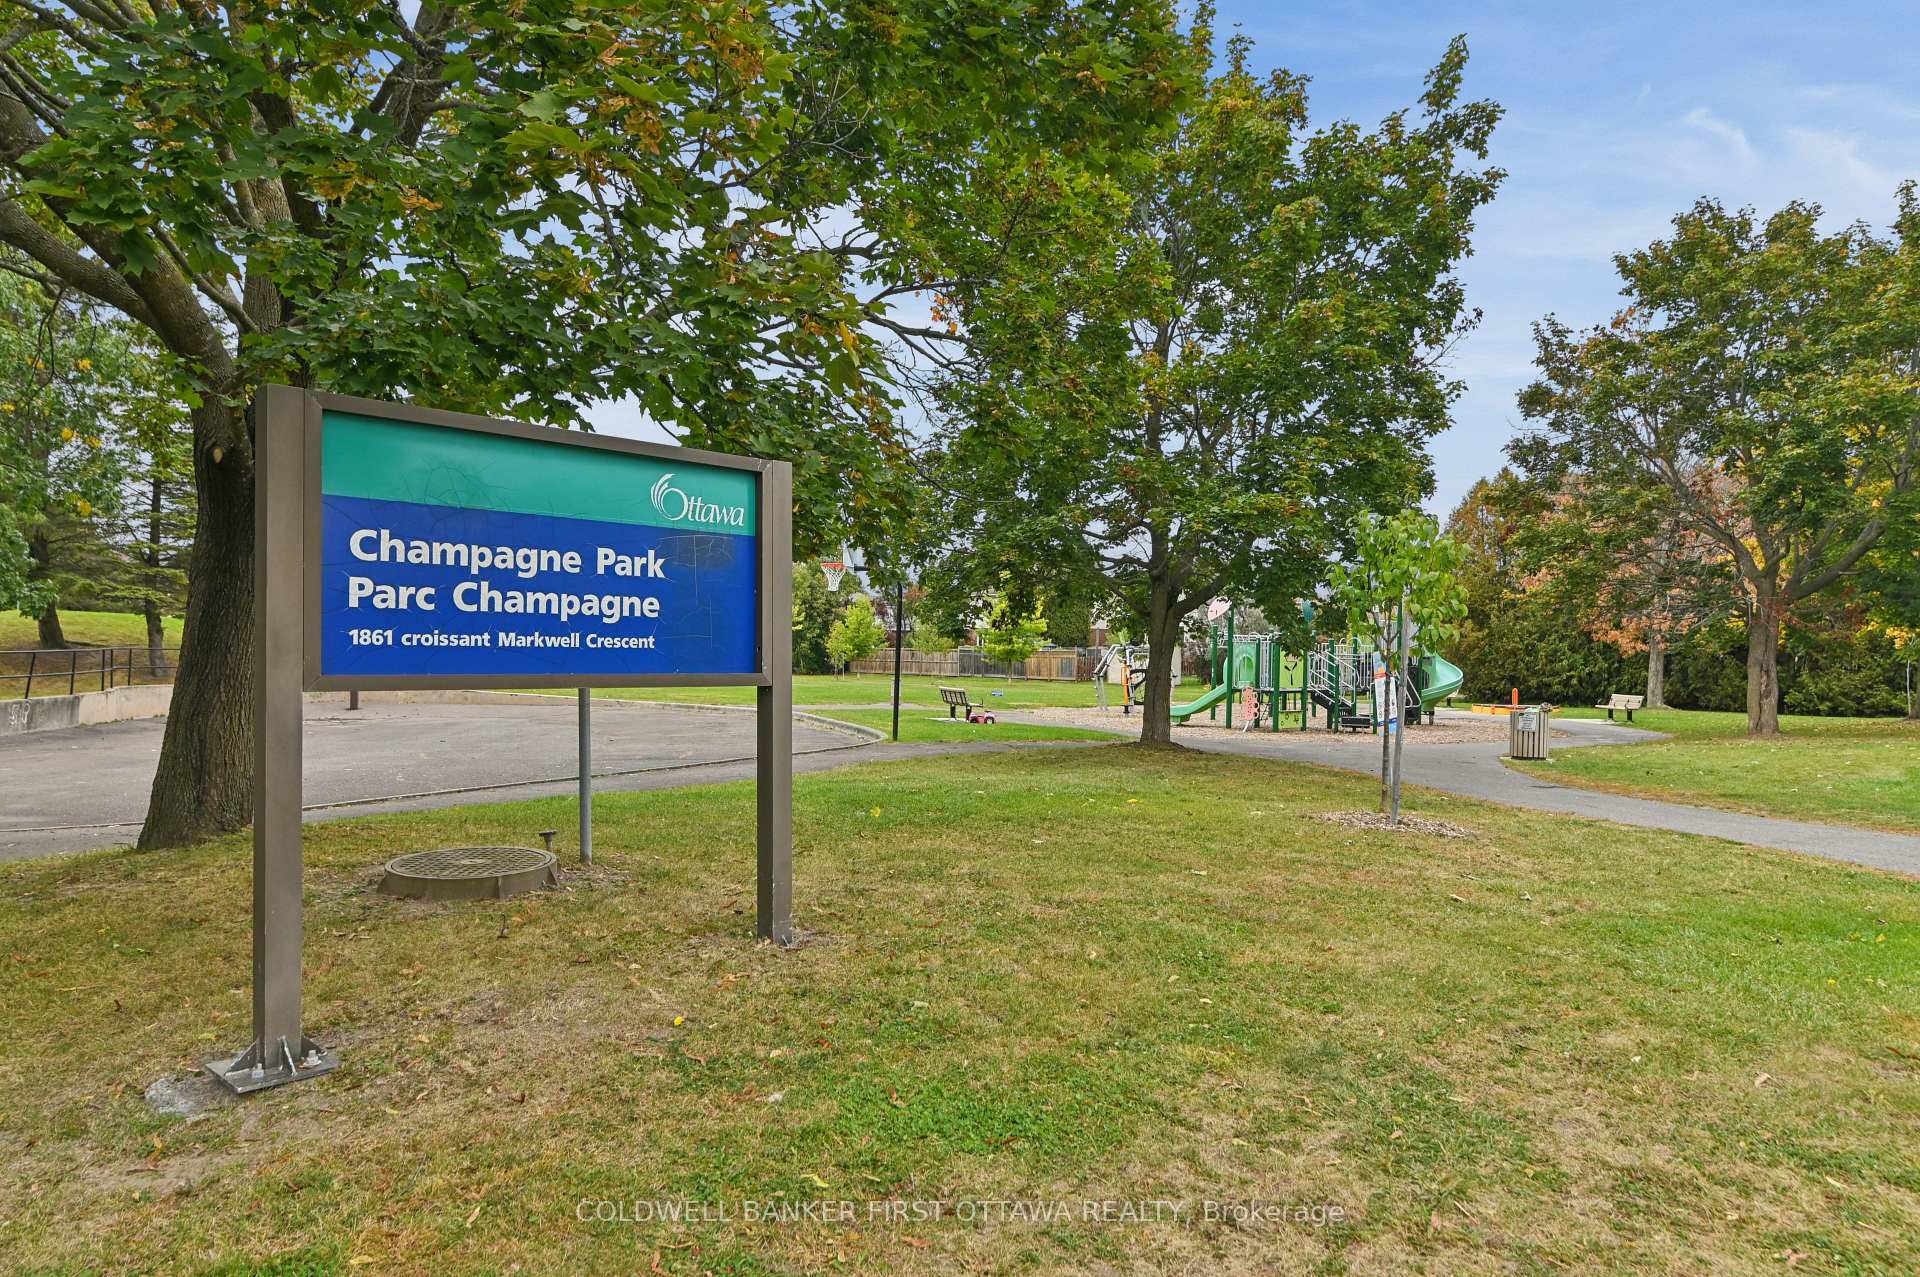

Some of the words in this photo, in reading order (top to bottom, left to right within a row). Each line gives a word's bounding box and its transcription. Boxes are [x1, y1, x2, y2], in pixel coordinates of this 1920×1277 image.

[656, 482, 745, 528] Ottawa
[349, 528, 582, 580] Champagne
[596, 547, 666, 579] Park
[348, 576, 436, 612] Parc
[452, 581, 661, 625] Champagne
[348, 629, 393, 646] 1861
[401, 630, 491, 647] croissant
[498, 631, 580, 648] Markwell
[586, 633, 656, 649] Crescent
